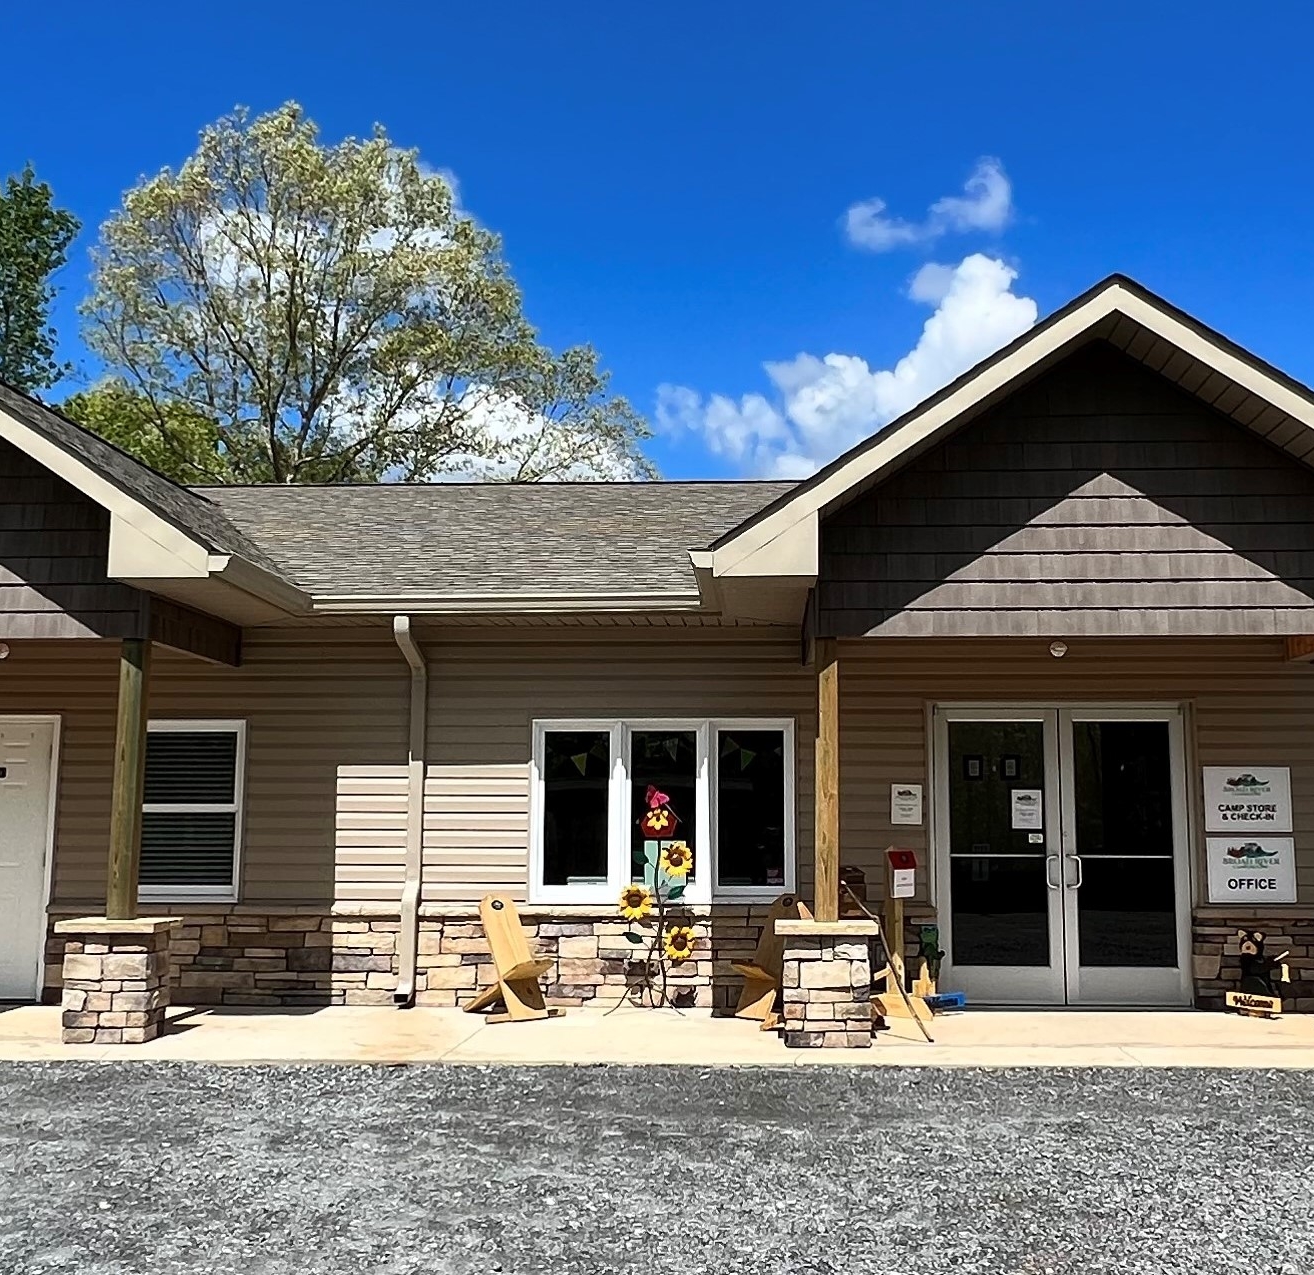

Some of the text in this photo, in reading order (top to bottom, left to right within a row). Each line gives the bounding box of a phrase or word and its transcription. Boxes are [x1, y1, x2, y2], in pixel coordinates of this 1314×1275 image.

[1218, 804, 1277, 812] CAMP STORE
[1230, 813, 1275, 821] CHECK-IN
[1227, 878, 1277, 890] OFFICE
